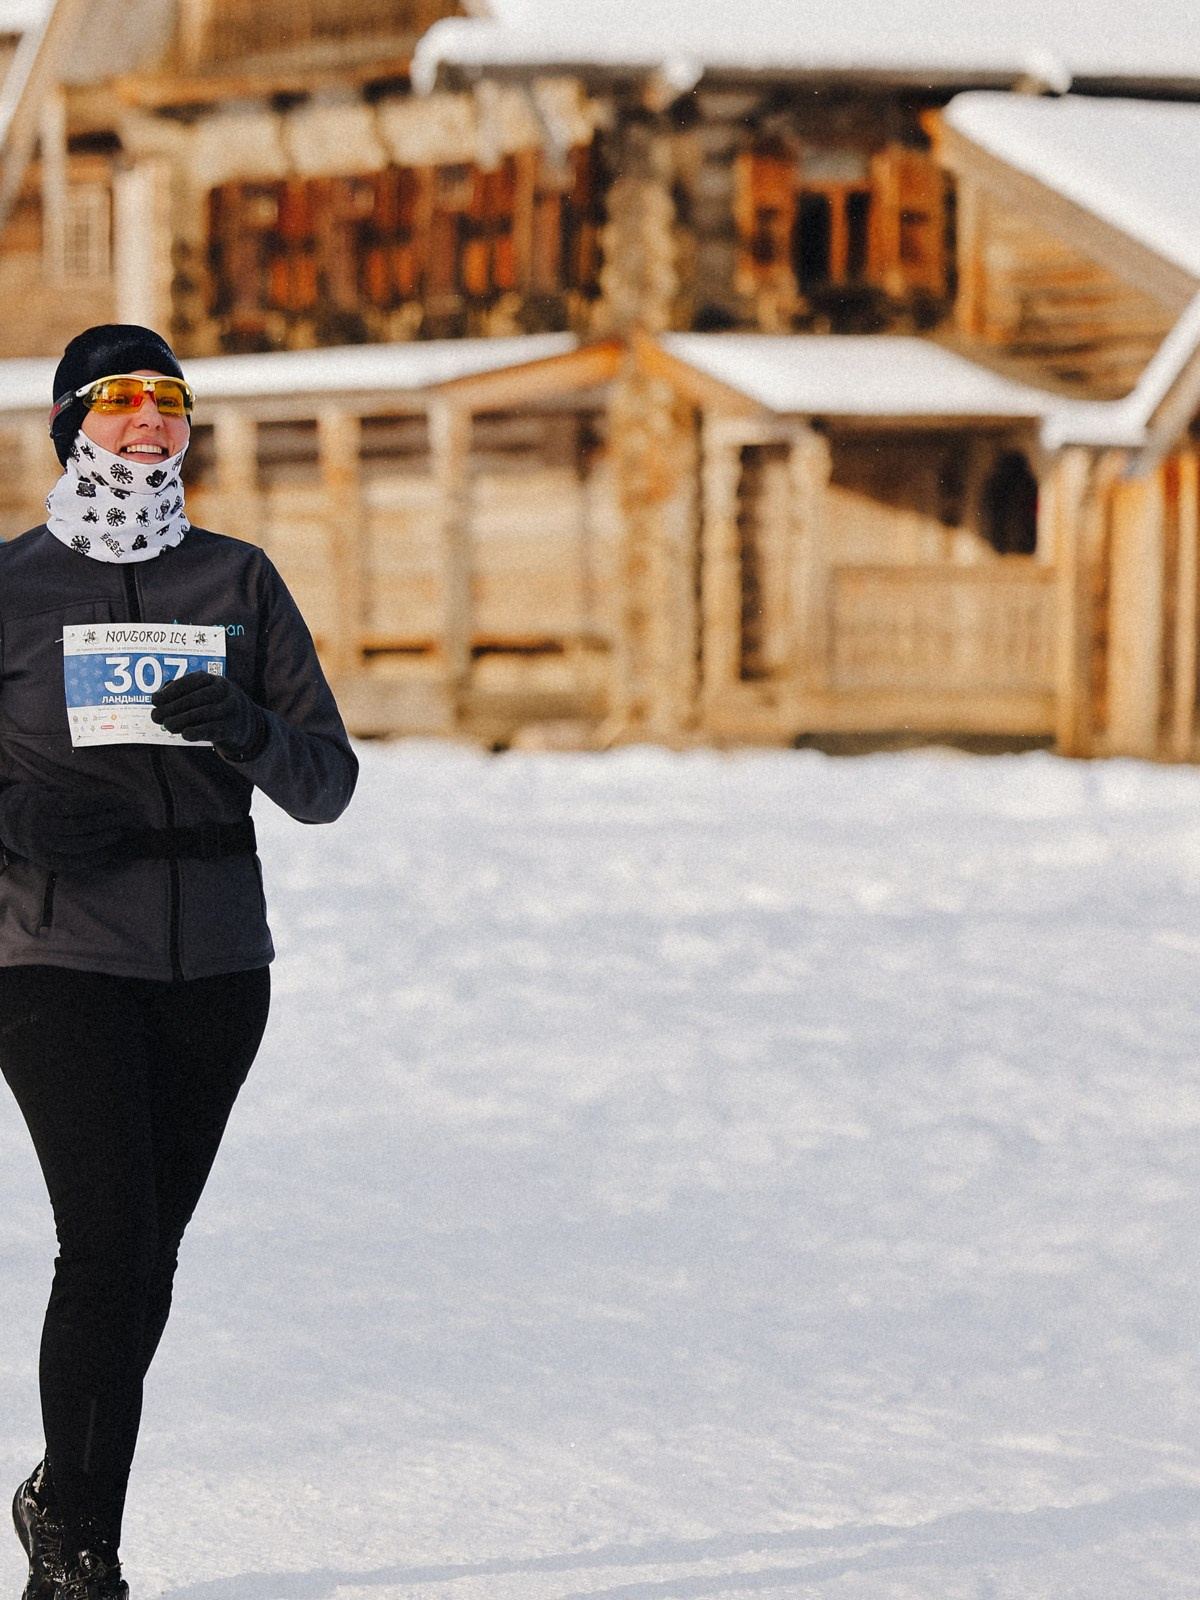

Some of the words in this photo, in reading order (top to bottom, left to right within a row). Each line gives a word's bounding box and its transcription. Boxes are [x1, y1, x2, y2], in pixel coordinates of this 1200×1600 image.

[105, 630, 167, 643] NOVGOROD
[169, 632, 187, 645] ICE
[104, 656, 189, 694] 307
[101, 694, 152, 704] ЛАНДЫШЕ
